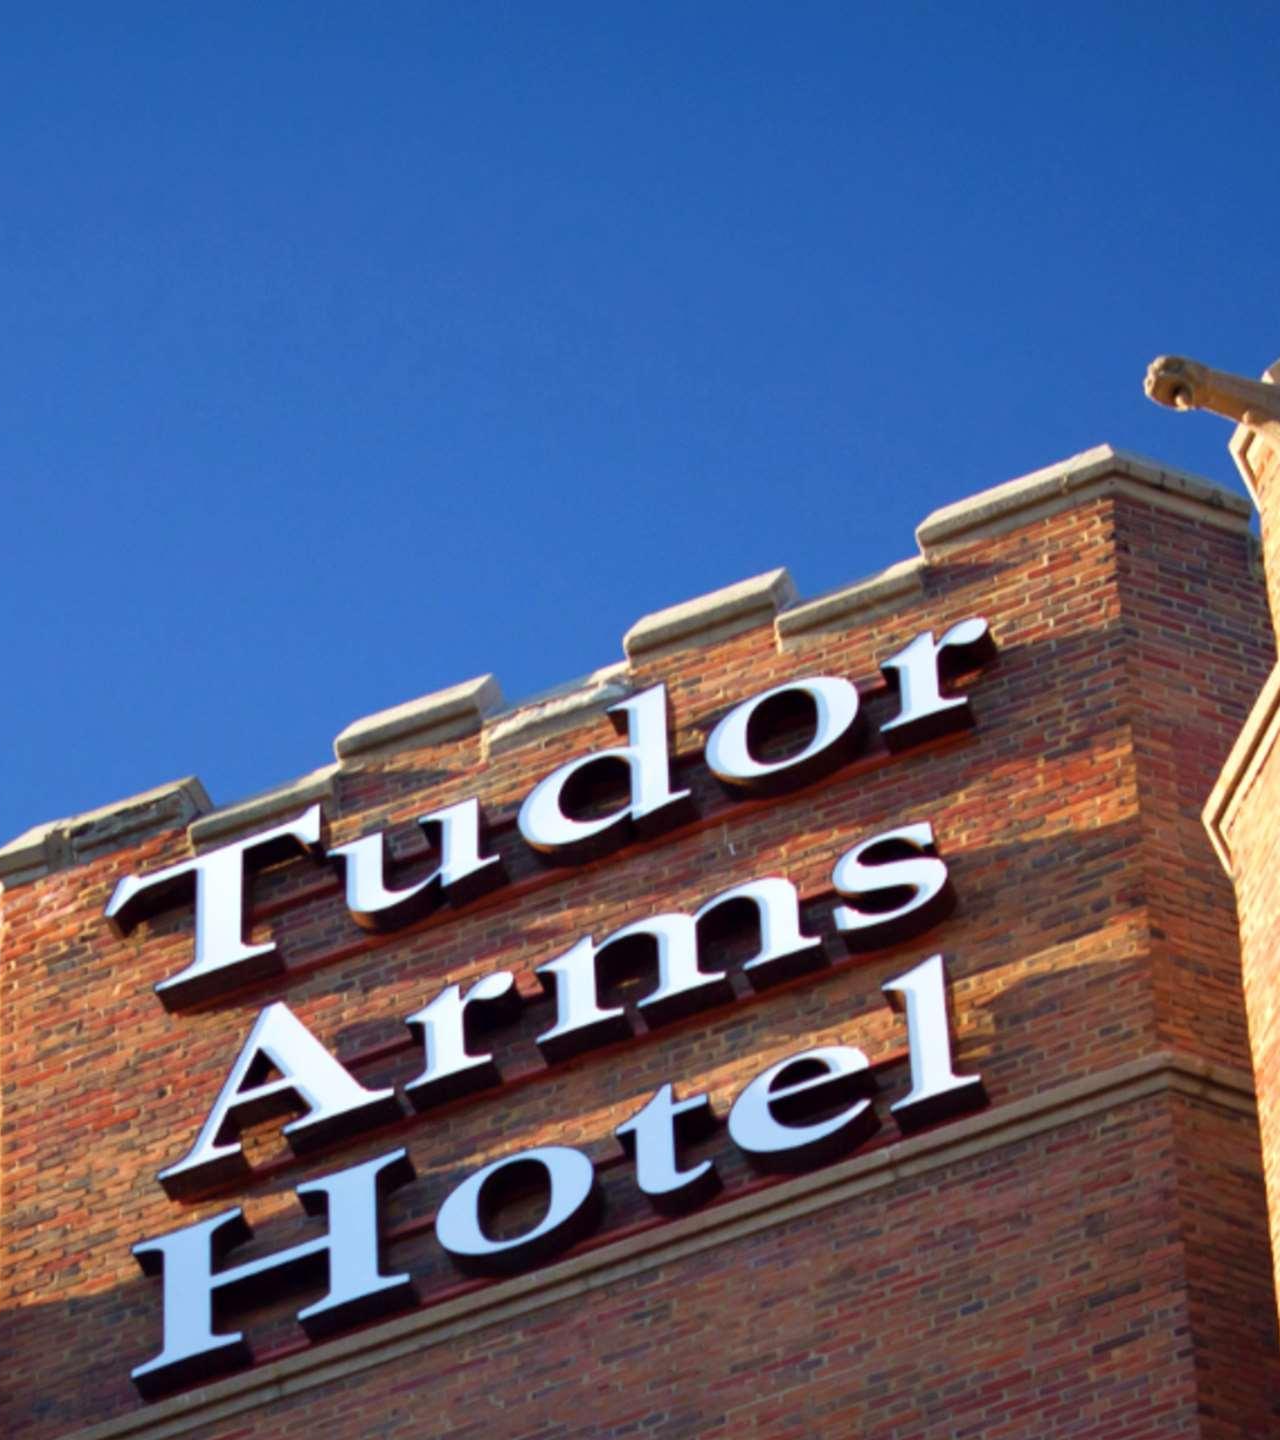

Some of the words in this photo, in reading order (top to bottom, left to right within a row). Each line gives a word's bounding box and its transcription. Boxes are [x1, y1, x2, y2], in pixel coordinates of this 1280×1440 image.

[104, 616, 991, 993] Tudor
[130, 954, 983, 1377] Hotel
[157, 821, 949, 1180] Arms
